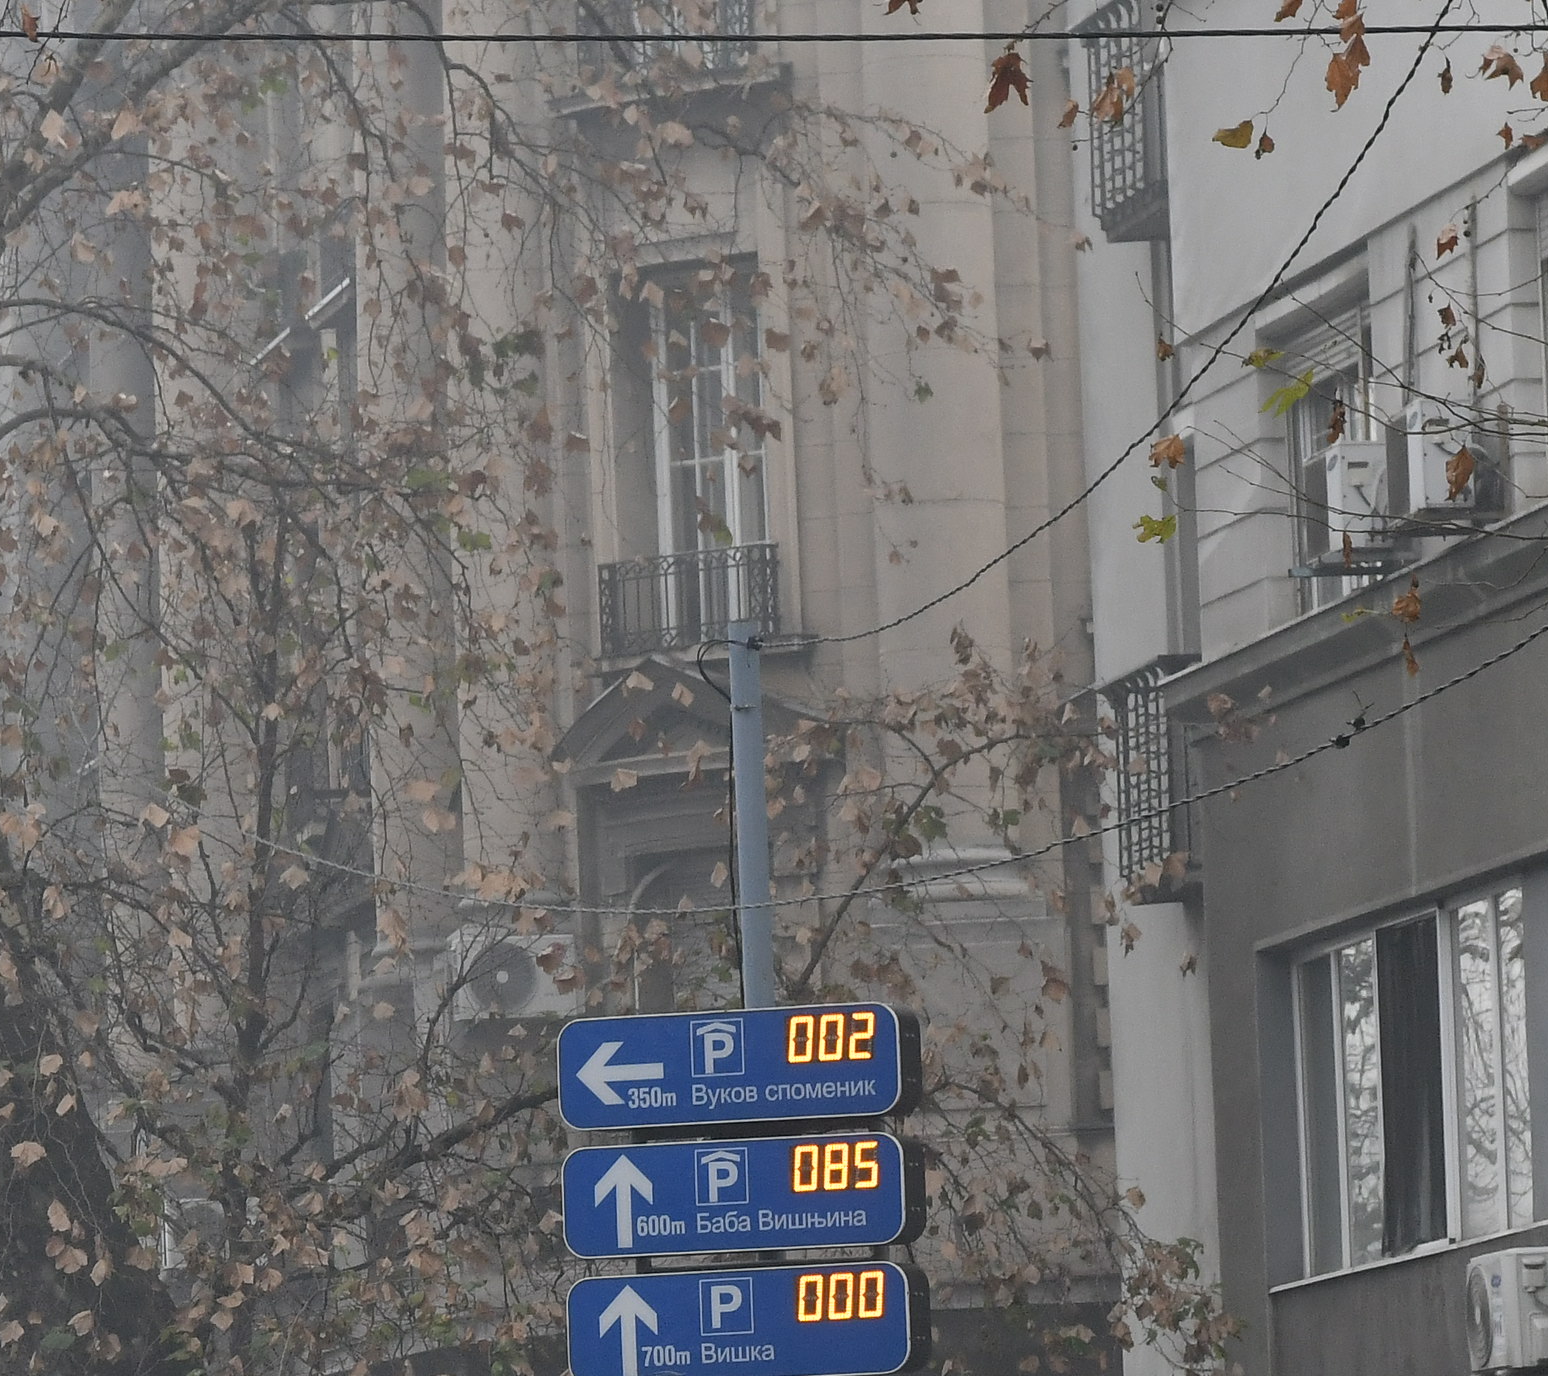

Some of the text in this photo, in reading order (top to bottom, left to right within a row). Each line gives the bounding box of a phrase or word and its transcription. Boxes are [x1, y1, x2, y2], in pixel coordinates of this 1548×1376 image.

[788, 1011, 876, 1065] 002
[628, 1086, 678, 1109] 350m
[691, 1079, 877, 1110] Вуков споменик
[792, 1140, 880, 1194] 085
[636, 1214, 687, 1237] 600m
[696, 1209, 867, 1234] Баба Вишњина
[797, 1269, 885, 1323] 000
[641, 1346, 691, 1367] 700m
[700, 1344, 776, 1365] Вишка
